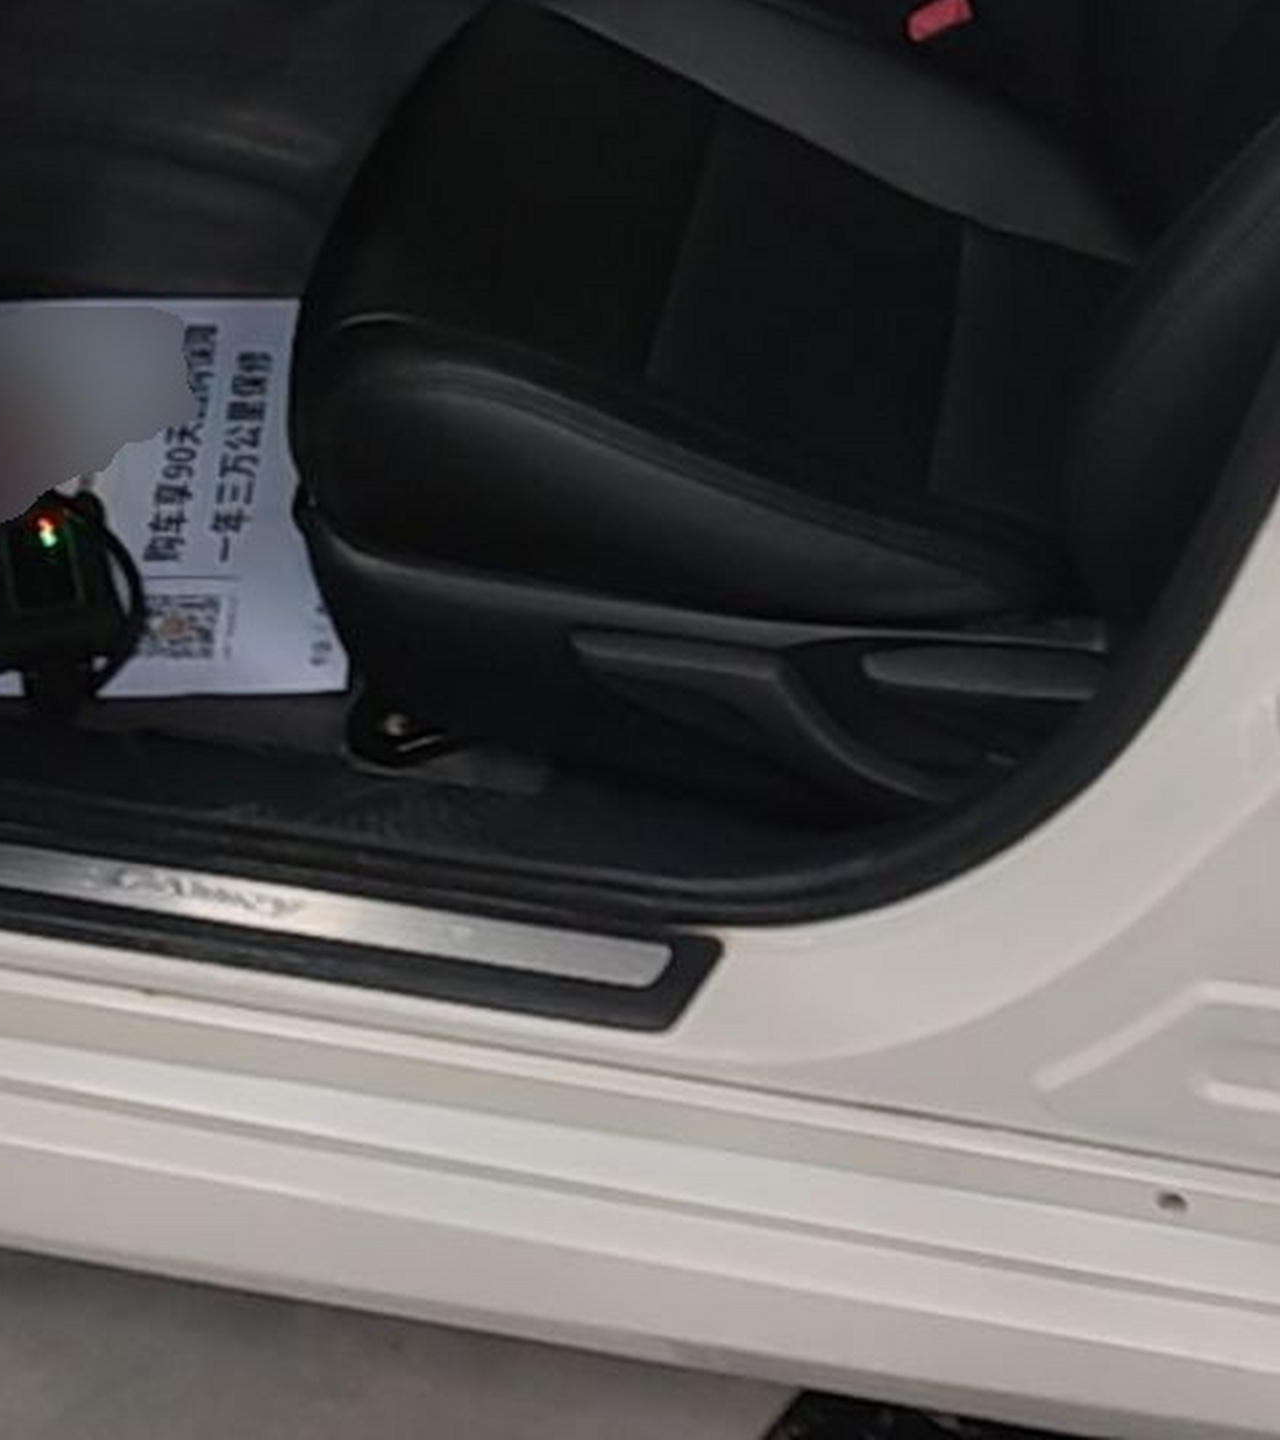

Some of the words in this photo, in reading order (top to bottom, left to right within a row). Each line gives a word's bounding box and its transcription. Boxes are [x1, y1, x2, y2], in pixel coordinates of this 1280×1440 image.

[210, 351, 273, 562] 一年三万公里保修
